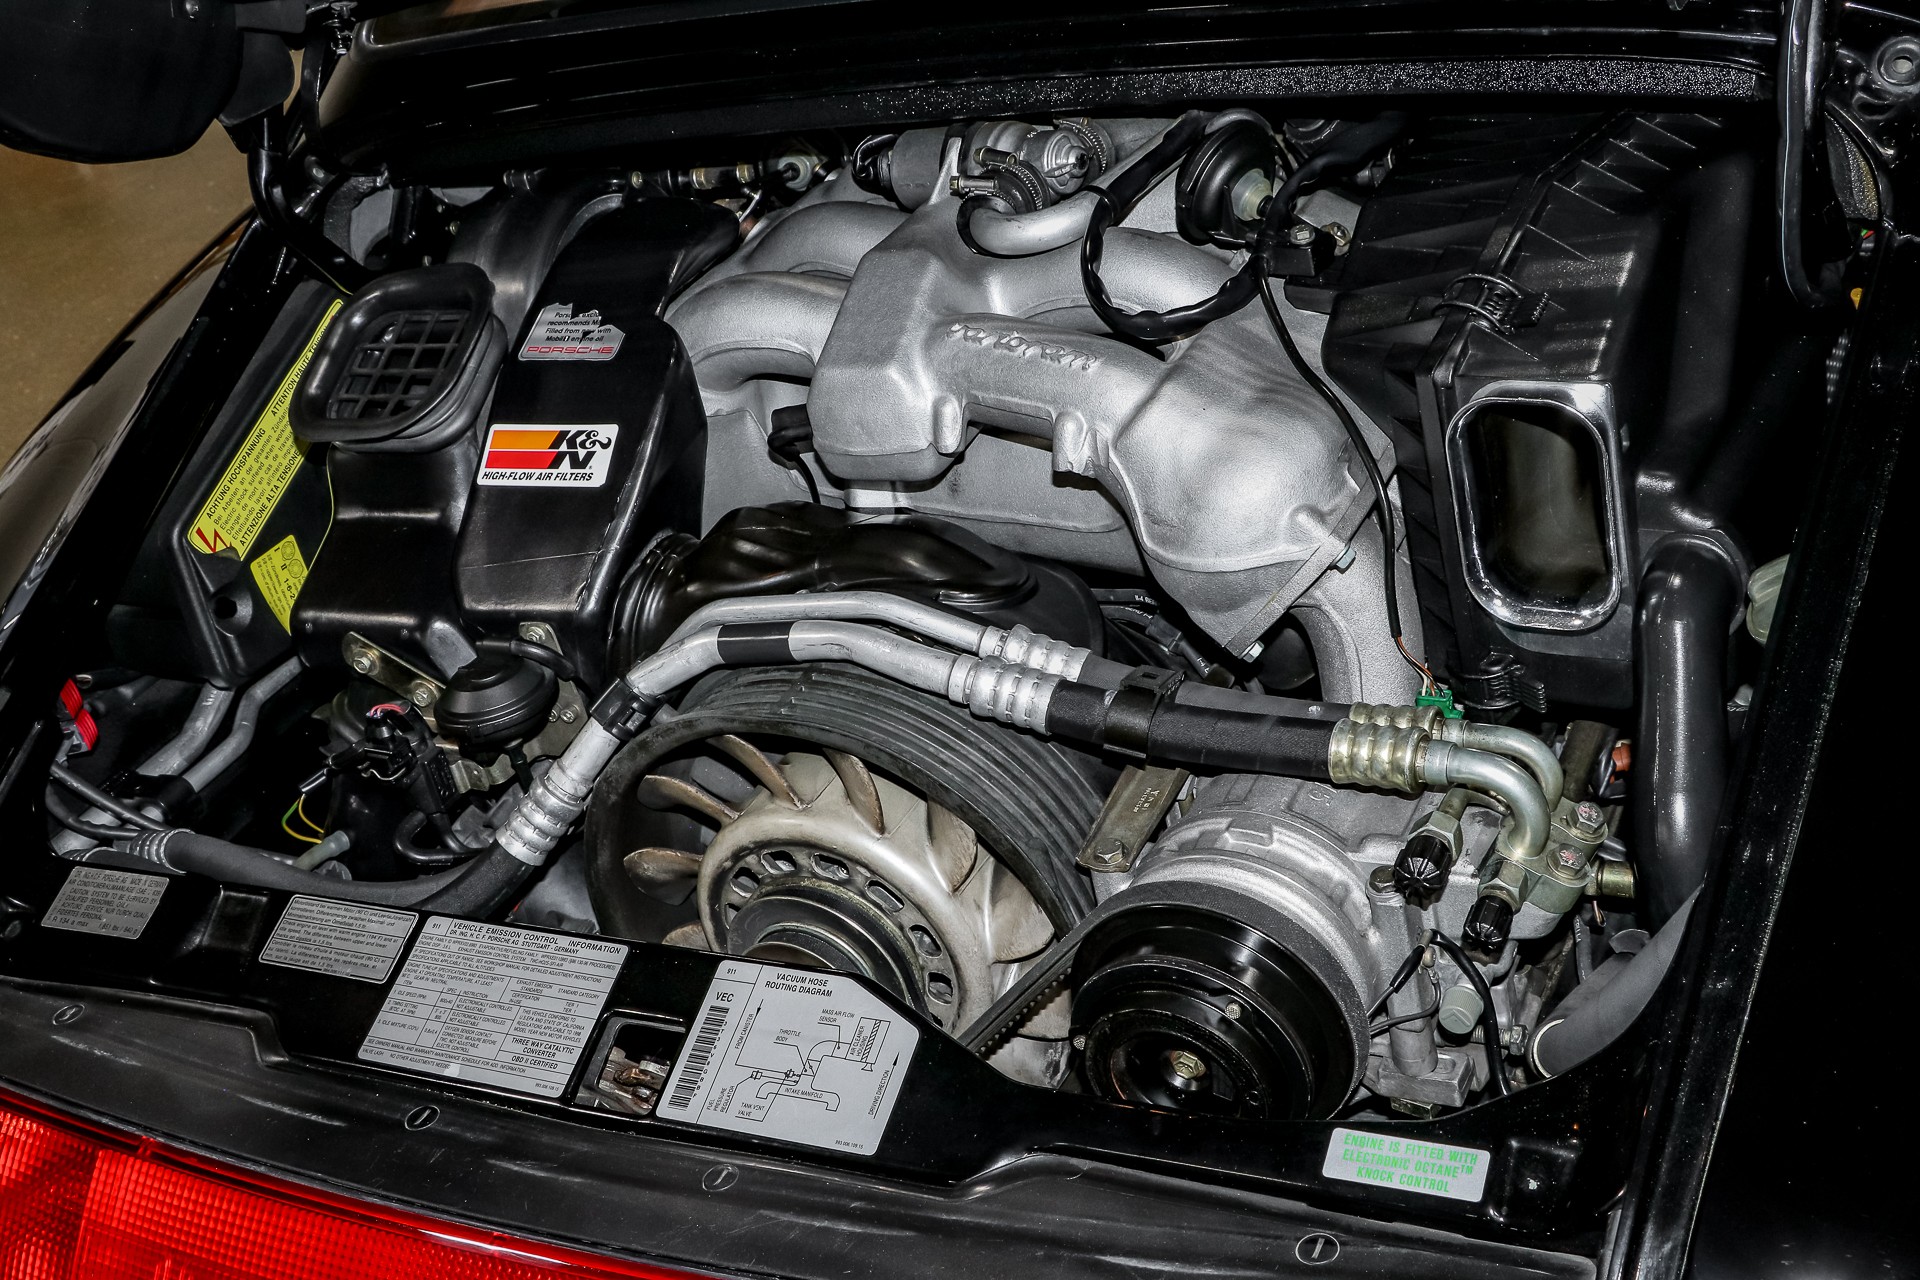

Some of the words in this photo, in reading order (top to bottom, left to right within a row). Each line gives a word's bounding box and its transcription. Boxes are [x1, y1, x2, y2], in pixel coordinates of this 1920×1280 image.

[269, 377, 298, 416] ATTENTION
[204, 484, 231, 519] ACHTUNG
[225, 427, 267, 485] HOCHSPANNUNG
[212, 513, 223, 525] Bei
[220, 486, 240, 512] Arbeiten
[238, 476, 246, 485] an
[244, 463, 255, 475] der
[251, 433, 274, 463] gesamten
[482, 472, 535, 480] HIGH-FLOW
[554, 473, 594, 481] FILTERS
[218, 506, 237, 530] Electric
[234, 487, 249, 505] shock
[262, 443, 276, 460] when
[225, 511, 244, 536] Danger
[240, 502, 249, 511] de
[246, 485, 259, 501] mort
[257, 476, 265, 485] en
[263, 463, 273, 475] cas
[271, 452, 279, 462] de
[237, 502, 270, 546] ATTENZIONE
[264, 483, 280, 503] ALTA
[275, 449, 302, 484] TENSIONE
[451, 922, 484, 932] VEHICLE
[484, 927, 522, 938] EMISSION
[522, 933, 560, 944] CONTROL
[567, 940, 621, 954] INFORMATION
[486, 935, 511, 943] PORSCHE
[520, 940, 550, 949] STUTTGART
[553, 946, 579, 954] GERMANY
[725, 967, 737, 975] 911
[775, 971, 807, 984] VACUUM
[807, 976, 829, 987] HOSE
[511, 992, 540, 1001] CERTIFICATION
[714, 990, 735, 1003] VEC
[763, 979, 798, 993] ROUTING
[797, 984, 833, 998] DIAGRAM
[561, 1022, 585, 1030] CALIFORNIA
[818, 1015, 837, 1023] SENSOR
[734, 1035, 745, 1049] FROM
[740, 1013, 754, 1035] CANISTER
[778, 1028, 801, 1037] THROTTLE
[852, 1025, 866, 1047] CLEANER
[510, 1037, 530, 1045] THREE
[529, 1040, 544, 1048] WAY
[543, 1043, 575, 1054] CATALYTIC
[522, 1046, 556, 1058] CONVERTER
[848, 1047, 857, 1055] AIR
[854, 1035, 868, 1056] HOUSING
[510, 1055, 524, 1063] OBD
[528, 1058, 558, 1069] CERTIFIED
[712, 1087, 727, 1111] PRESSURE
[719, 1085, 735, 1112] REGULATOR
[783, 1087, 801, 1095] INTAKE
[800, 1089, 823, 1099] MANIFOLD
[867, 1095, 880, 1115] DRIVING
[874, 1069, 891, 1096] DIRECTION
[706, 1098, 715, 1110] FUEL
[737, 1109, 752, 1117] VALVE
[1343, 1133, 1385, 1151] ENGINE
[1388, 1141, 1401, 1152] IS
[1404, 1143, 1444, 1159] FITTED
[1447, 1150, 1478, 1165] WITH
[1342, 1148, 1410, 1170] ELECTRONIC
[1356, 1166, 1394, 1182] KNOCK
[1399, 1173, 1450, 1192] CONTROL
